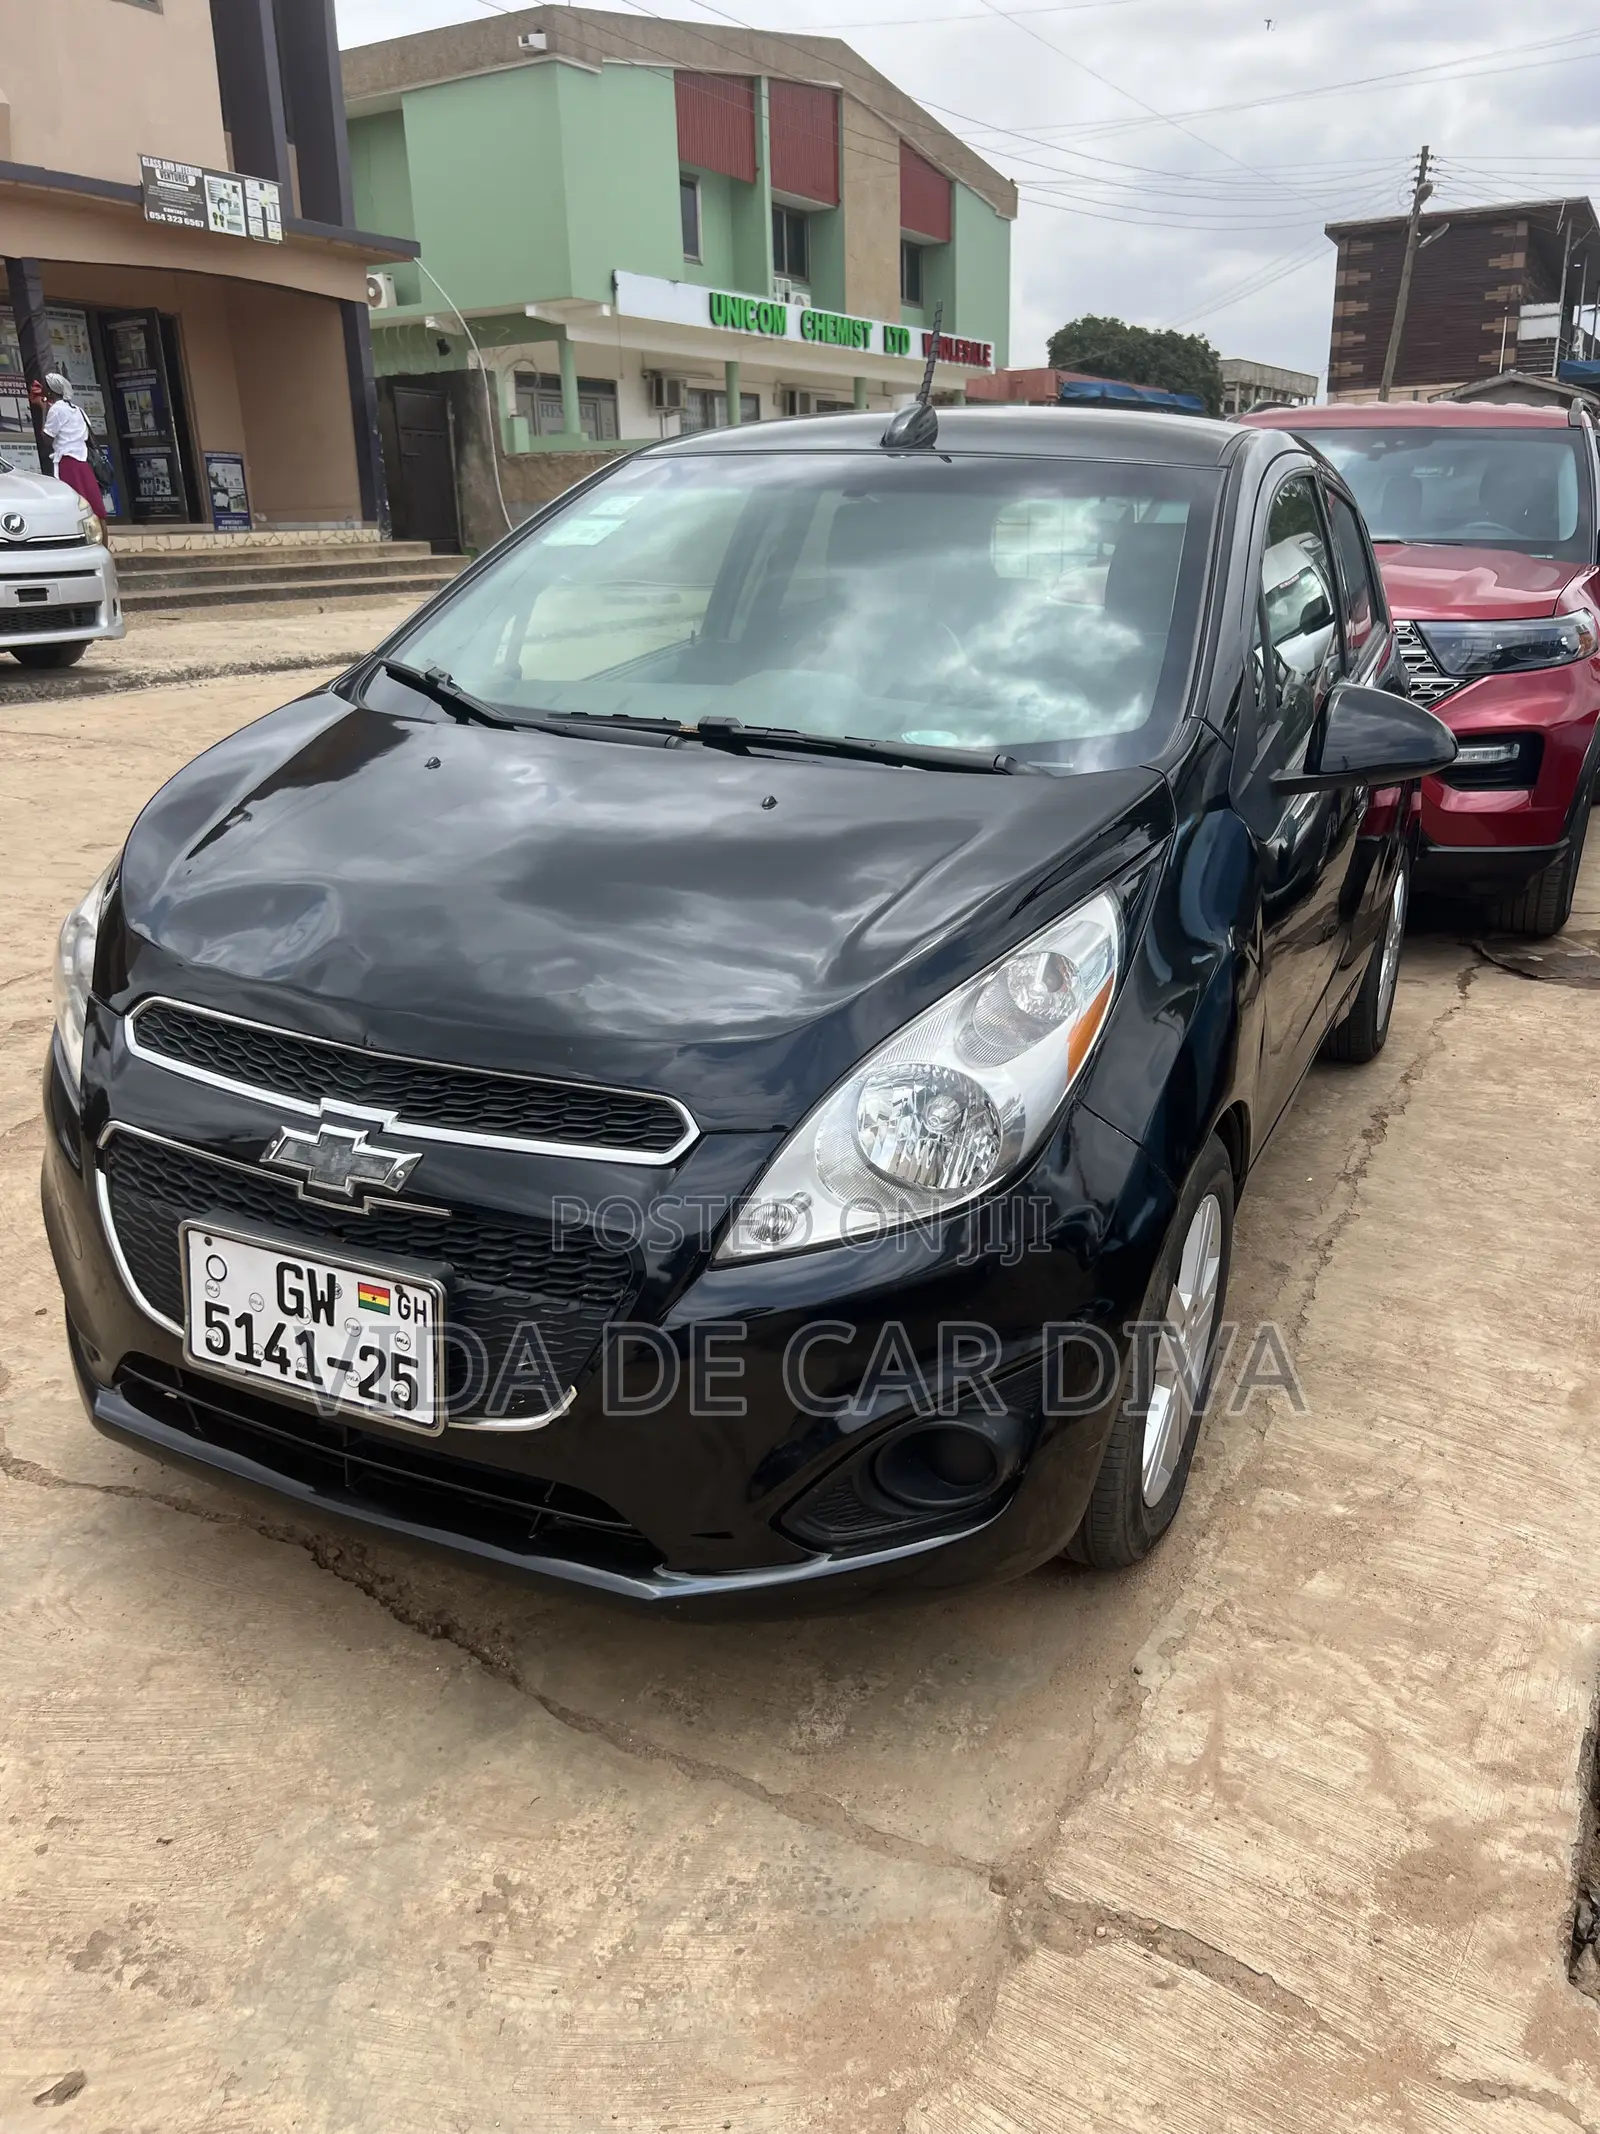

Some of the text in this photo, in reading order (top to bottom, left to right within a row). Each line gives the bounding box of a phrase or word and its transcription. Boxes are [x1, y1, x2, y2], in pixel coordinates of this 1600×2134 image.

[142, 157, 162, 169] GLASS
[162, 161, 175, 172] AND
[160, 169, 189, 184] VENTURES
[149, 211, 166, 221] 054
[167, 215, 183, 224] 323
[709, 292, 787, 336] UNICOM
[801, 310, 873, 349] CHEMIST
[883, 325, 910, 355] LTD
[277, 1261, 336, 1327] GW
[398, 1292, 427, 1328] GH
[205, 1301, 419, 1411] 5141-25
